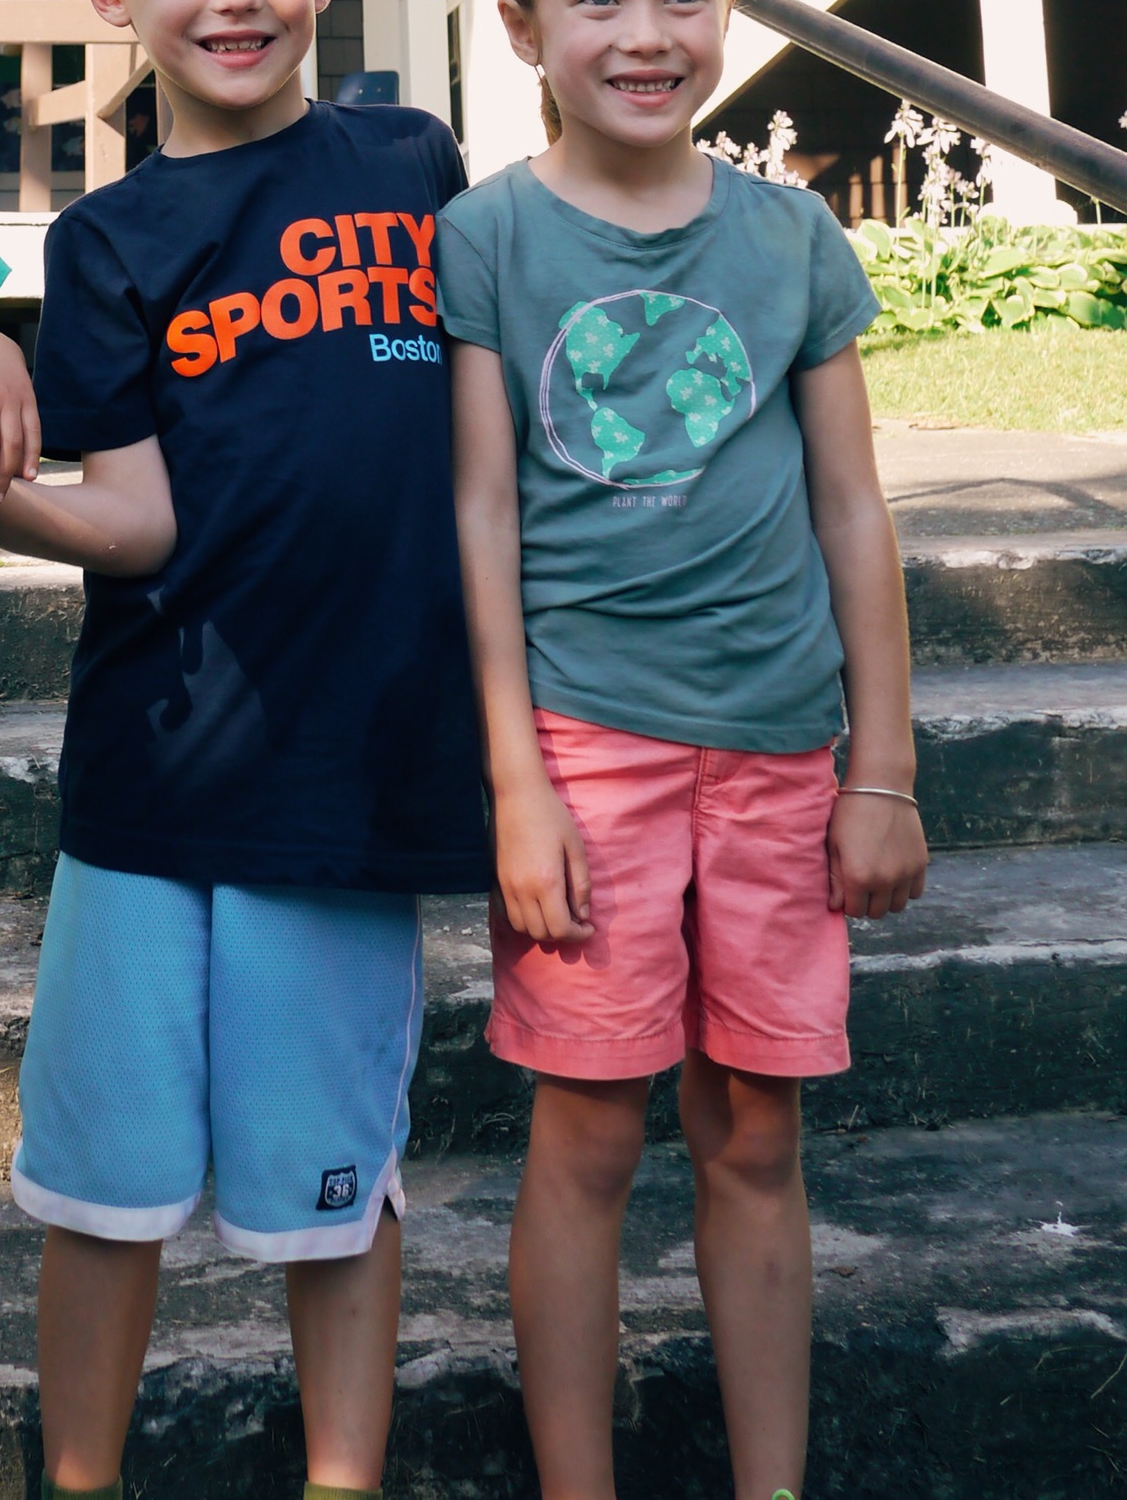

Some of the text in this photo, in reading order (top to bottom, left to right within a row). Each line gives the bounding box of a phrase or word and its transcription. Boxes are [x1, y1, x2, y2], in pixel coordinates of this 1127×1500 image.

[280, 212, 436, 276] CITY
[166, 266, 437, 377] SPORTS
[612, 494, 687, 508] PLANT THE WORLD
[333, 1183, 350, 1198] 36
